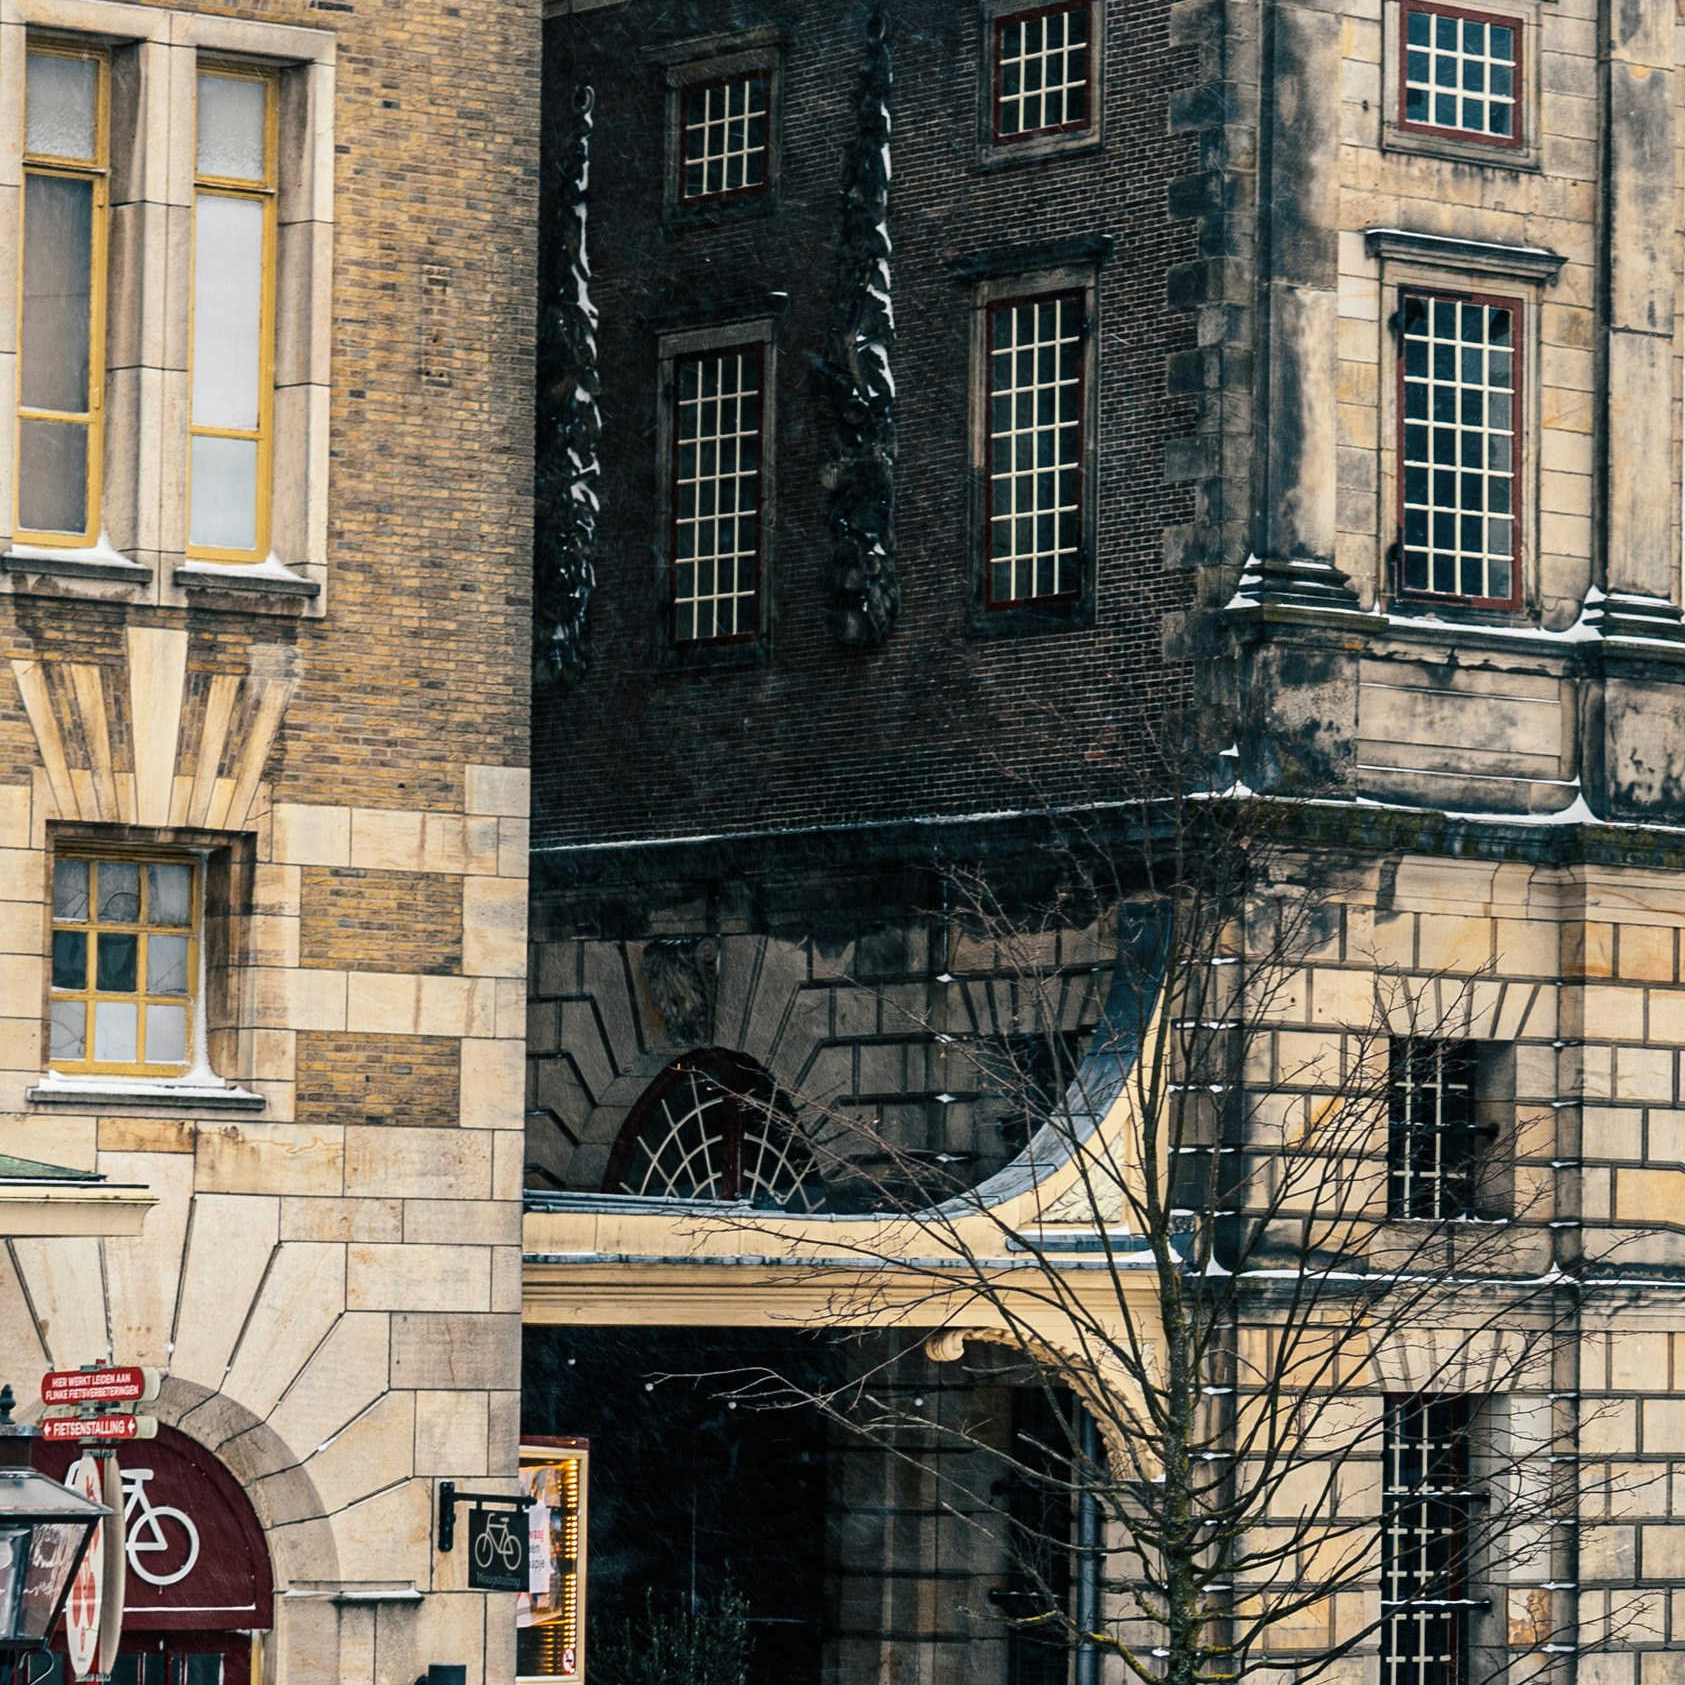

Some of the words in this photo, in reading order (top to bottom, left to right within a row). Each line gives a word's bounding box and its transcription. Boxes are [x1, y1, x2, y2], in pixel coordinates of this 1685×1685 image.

[52, 1377, 67, 1388] HIER
[68, 1375, 91, 1387] WERKT
[92, 1374, 115, 1386] LEIDEN
[115, 1373, 131, 1384] AAN
[45, 1389, 68, 1401] FLINKE
[69, 1384, 139, 1399] FIETSVERBETERINGEN
[53, 1419, 125, 1437] FIETSENSTALLING
